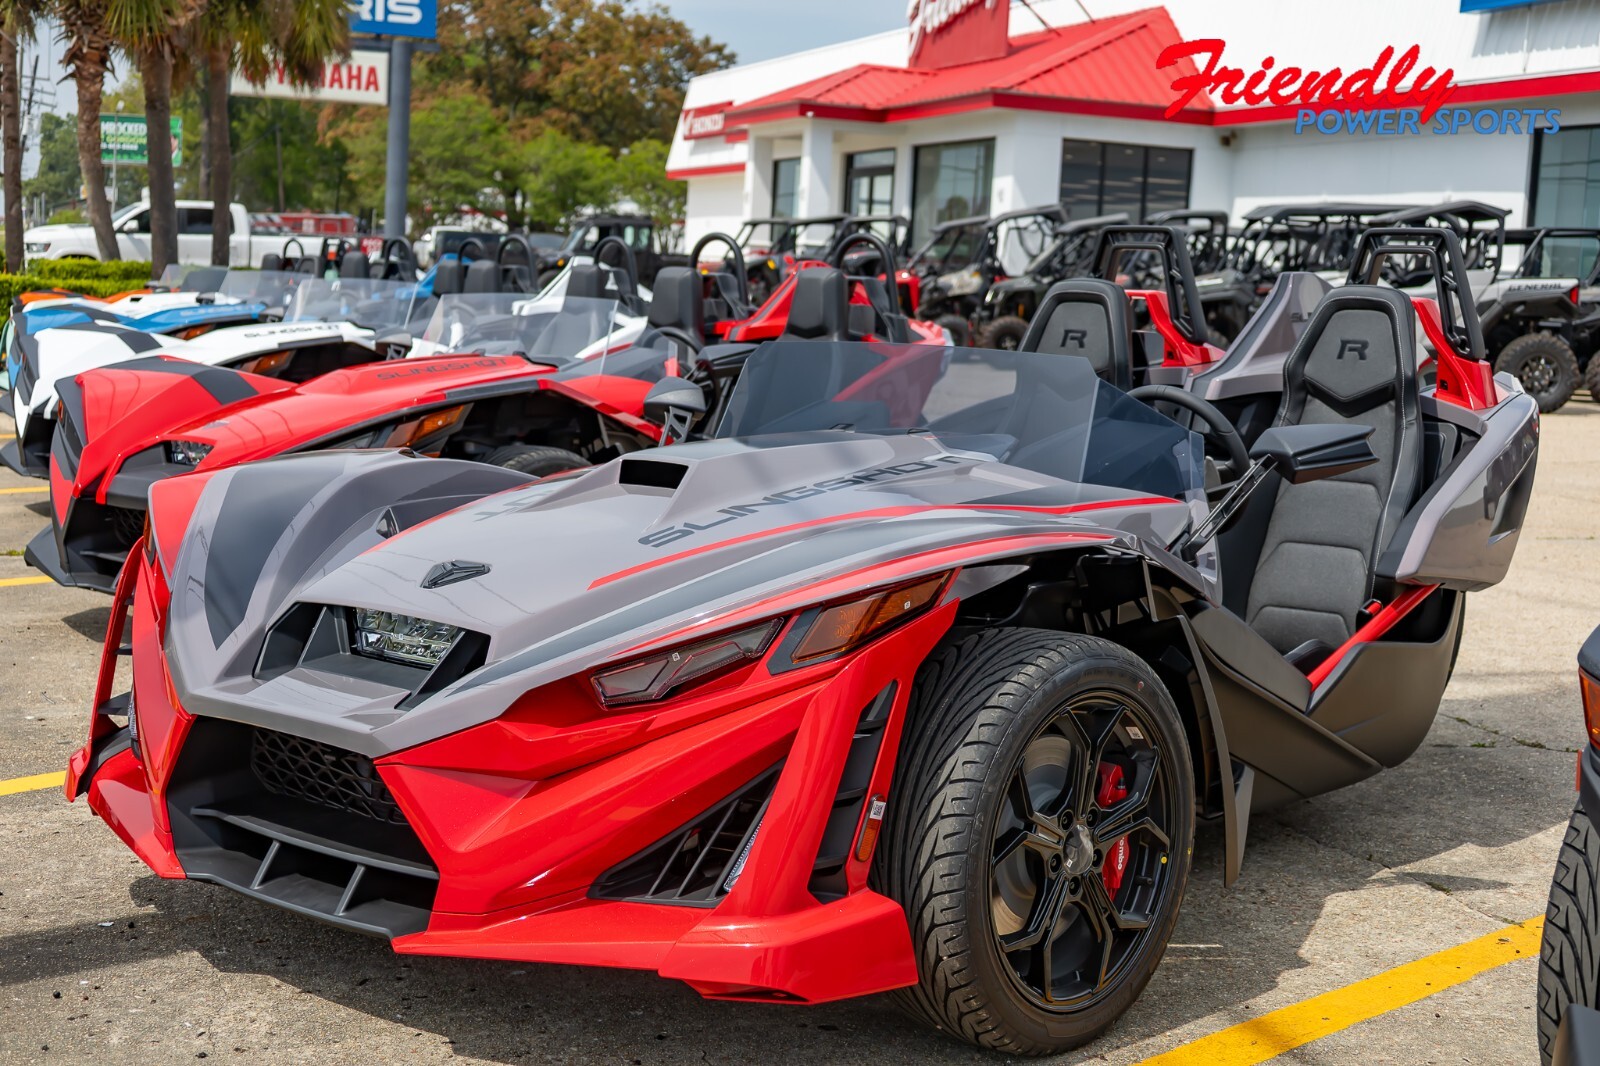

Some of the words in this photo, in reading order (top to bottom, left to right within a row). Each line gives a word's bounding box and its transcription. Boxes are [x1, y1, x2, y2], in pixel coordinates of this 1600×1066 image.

[1060, 328, 1088, 349] R
[1336, 339, 1370, 361] R
[376, 358, 507, 380] SLINGSHOT
[637, 455, 970, 548] SLINGSHOT
